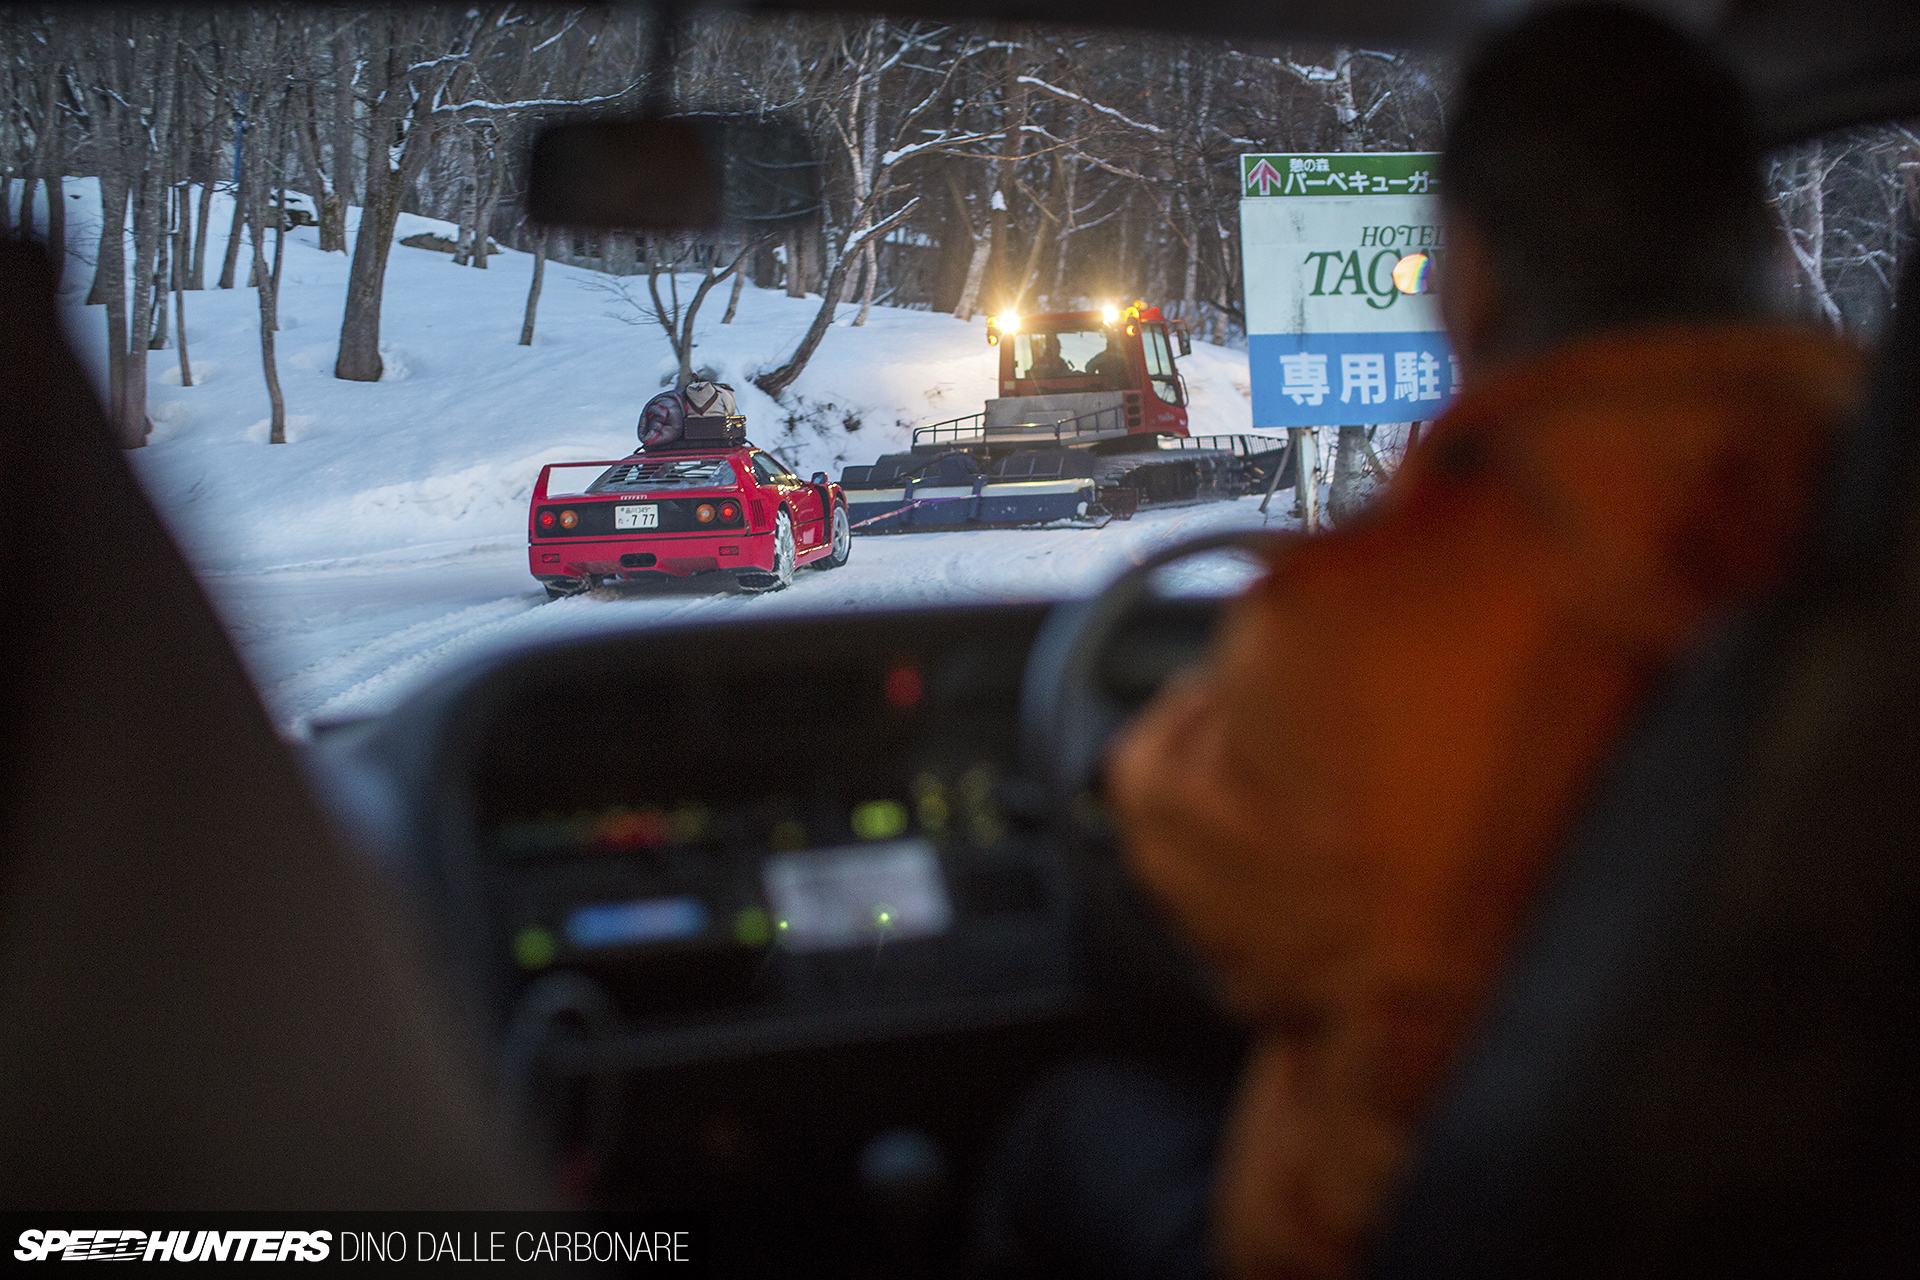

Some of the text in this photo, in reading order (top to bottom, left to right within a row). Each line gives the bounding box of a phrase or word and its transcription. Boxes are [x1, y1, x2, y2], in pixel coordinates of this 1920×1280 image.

[1304, 248, 1444, 310] TAG
[1279, 352, 1462, 406] 専用駐
